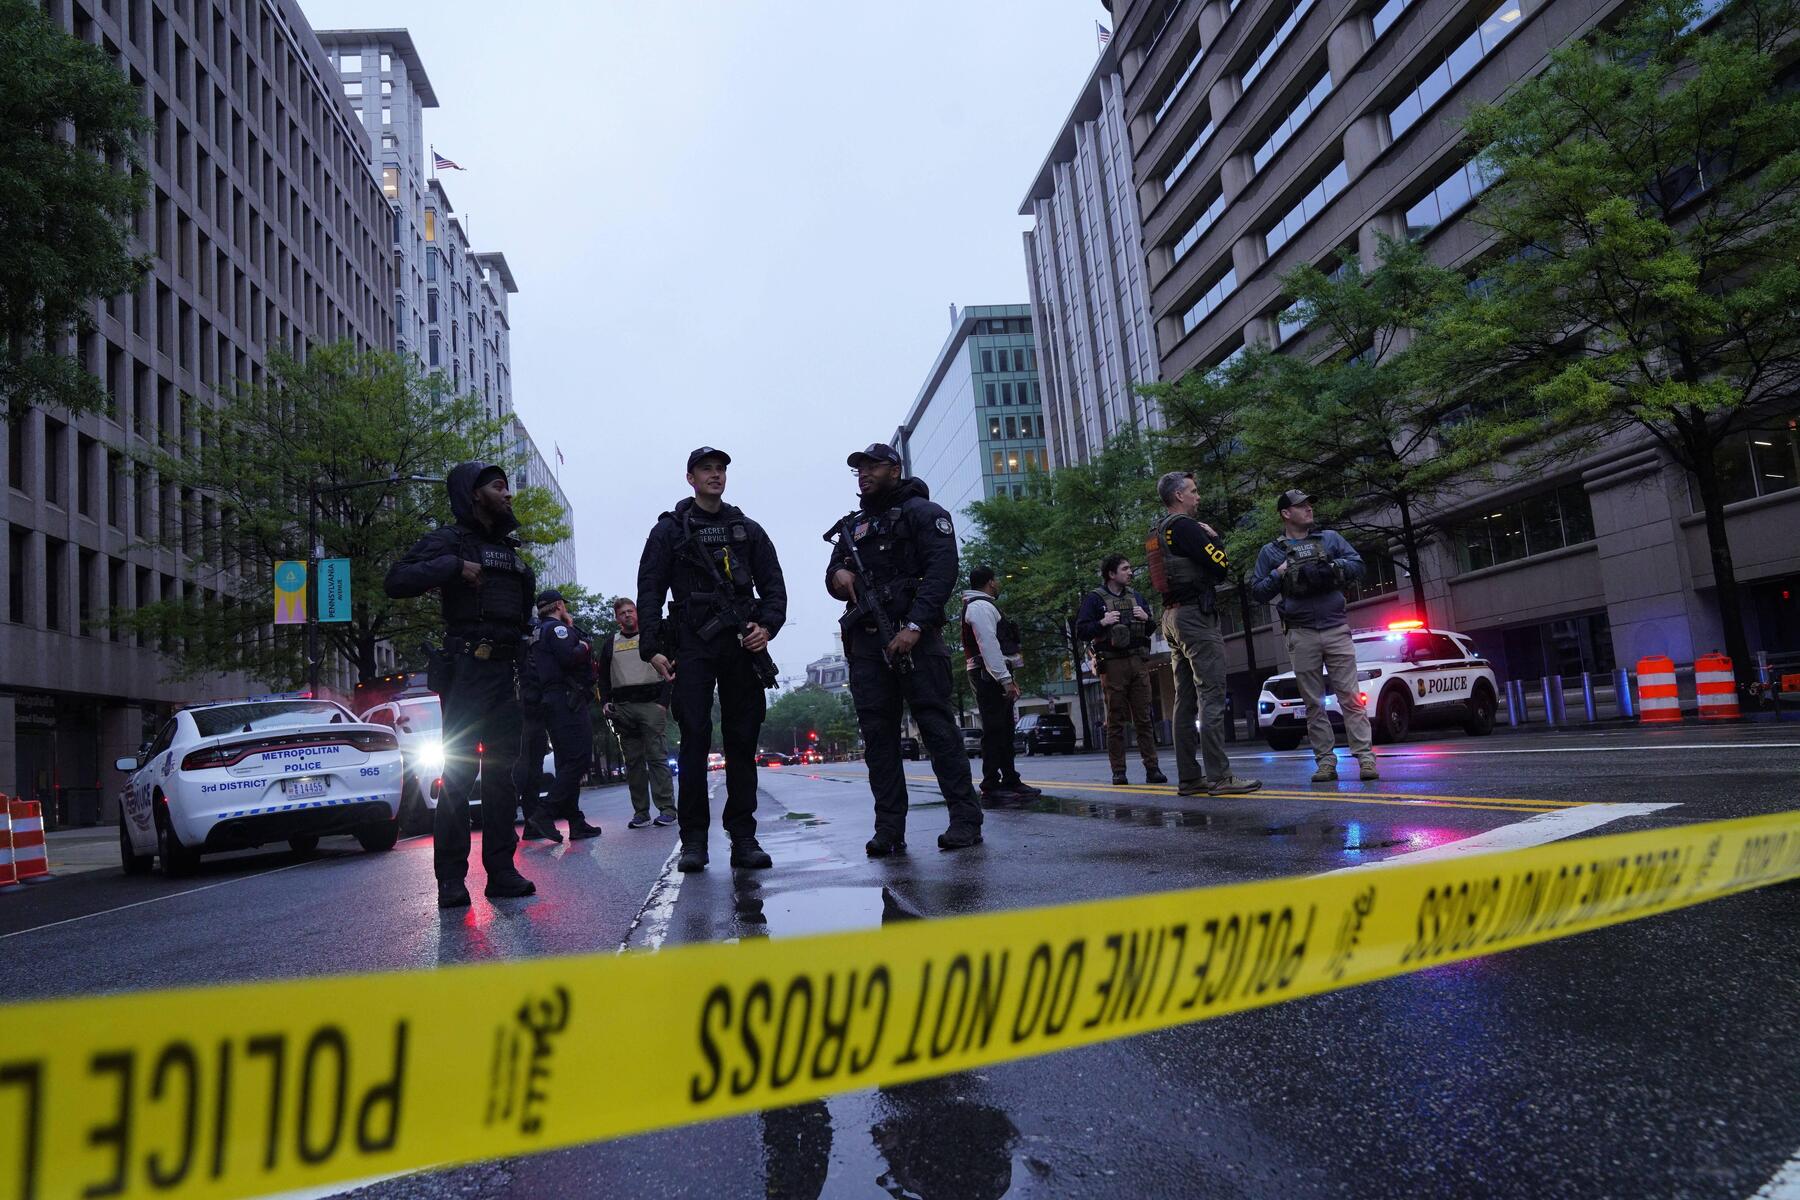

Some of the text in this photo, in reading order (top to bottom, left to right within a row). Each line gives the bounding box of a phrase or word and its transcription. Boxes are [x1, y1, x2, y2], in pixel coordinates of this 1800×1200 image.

[699, 527, 726, 535] SECRET
[485, 551, 511, 560] SECRET
[1299, 550, 1312, 558] DSS
[485, 559, 512, 570] SERVICE
[327, 563, 336, 618] PENNSYLVANIA
[1428, 676, 1468, 694] POLICE
[262, 746, 340, 761] METROPOLITAN
[284, 761, 322, 772] POLICE
[360, 767, 380, 777] 965
[201, 779, 268, 793] 3rd DISTRICT
[1180, 905, 1316, 1008] POLICE
[1083, 924, 1188, 1029] LINE
[1010, 939, 1086, 1043] DO
[896, 949, 1011, 1064] NOT
[690, 963, 893, 1107] CROSS
[82, 1018, 411, 1199] POLICE
